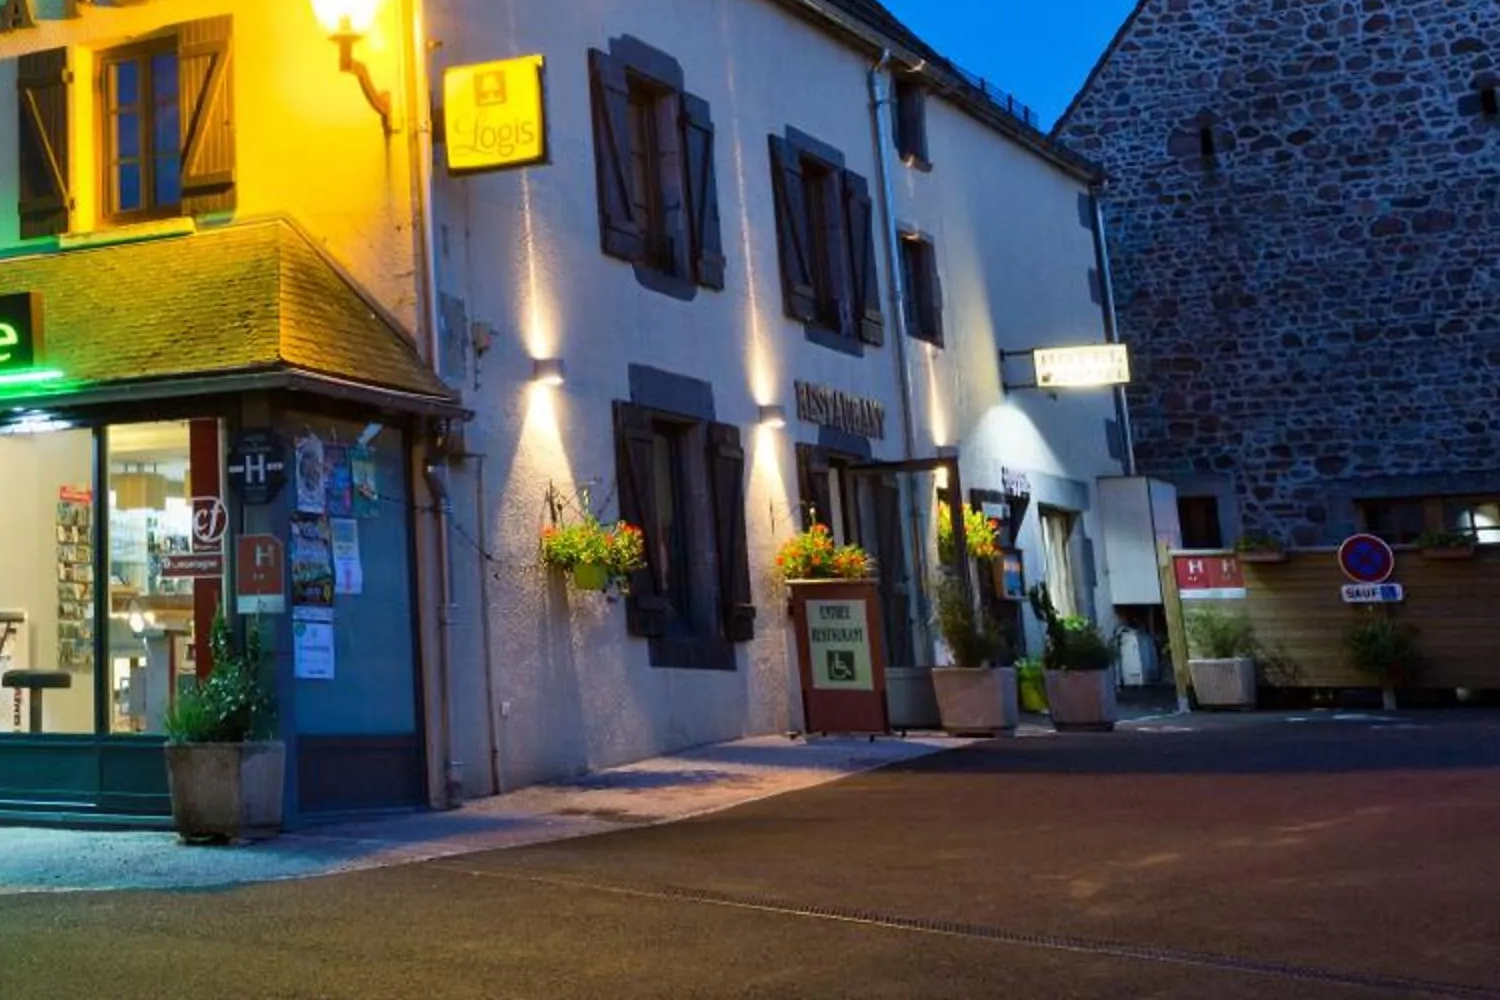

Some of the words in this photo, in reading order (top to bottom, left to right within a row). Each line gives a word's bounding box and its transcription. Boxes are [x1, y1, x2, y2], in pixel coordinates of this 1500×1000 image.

[452, 110, 535, 158] Logis
[793, 379, 885, 441] RESTAURANT
[254, 543, 274, 568] H
[1188, 559, 1204, 574] H
[1345, 587, 1379, 599] SAUF
